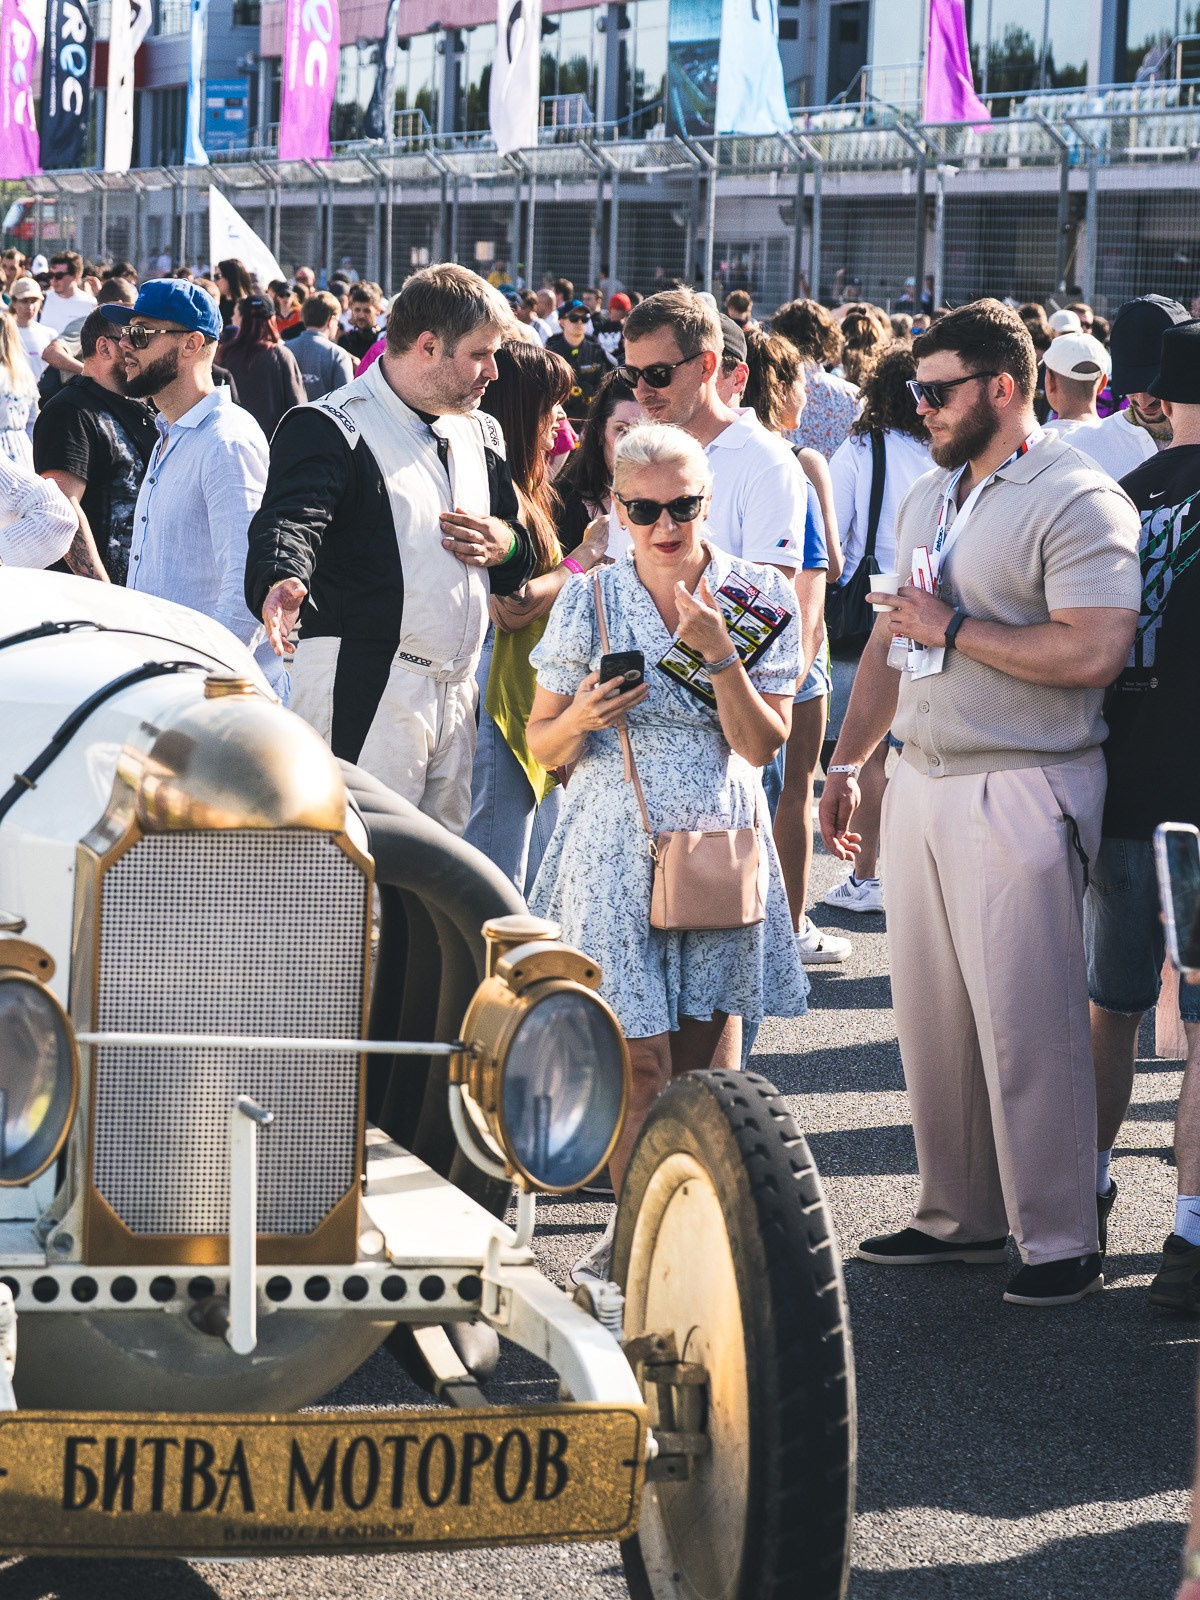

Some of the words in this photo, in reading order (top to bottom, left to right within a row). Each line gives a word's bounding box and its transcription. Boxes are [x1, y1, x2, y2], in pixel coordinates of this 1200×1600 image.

[399, 651, 432, 668] sparco
[62, 1436, 256, 1512] БИТВА
[288, 1427, 569, 1512] МОТОРОВ
